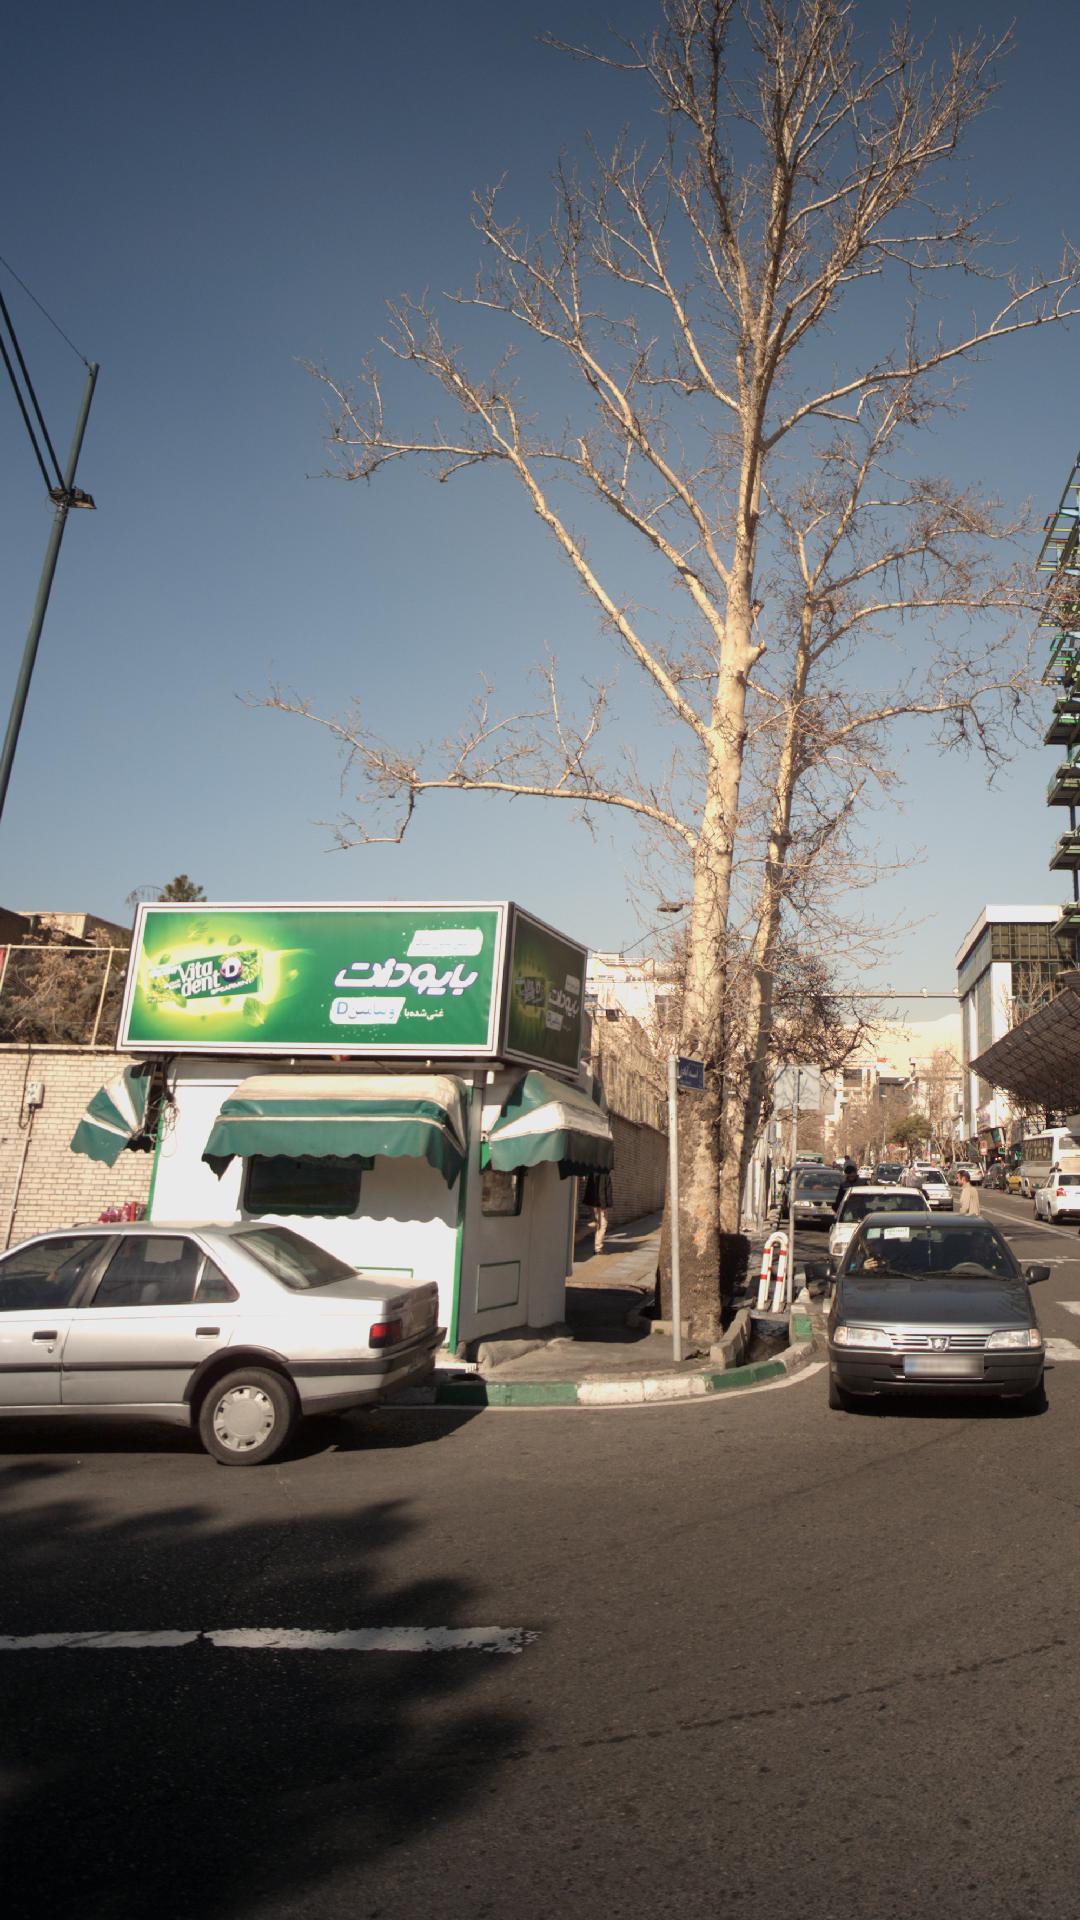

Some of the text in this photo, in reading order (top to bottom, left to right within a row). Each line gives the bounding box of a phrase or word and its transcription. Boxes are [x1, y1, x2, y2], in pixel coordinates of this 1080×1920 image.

[178, 961, 213, 982] Vita
[181, 970, 220, 996] dent
[336, 1001, 348, 1014] D
